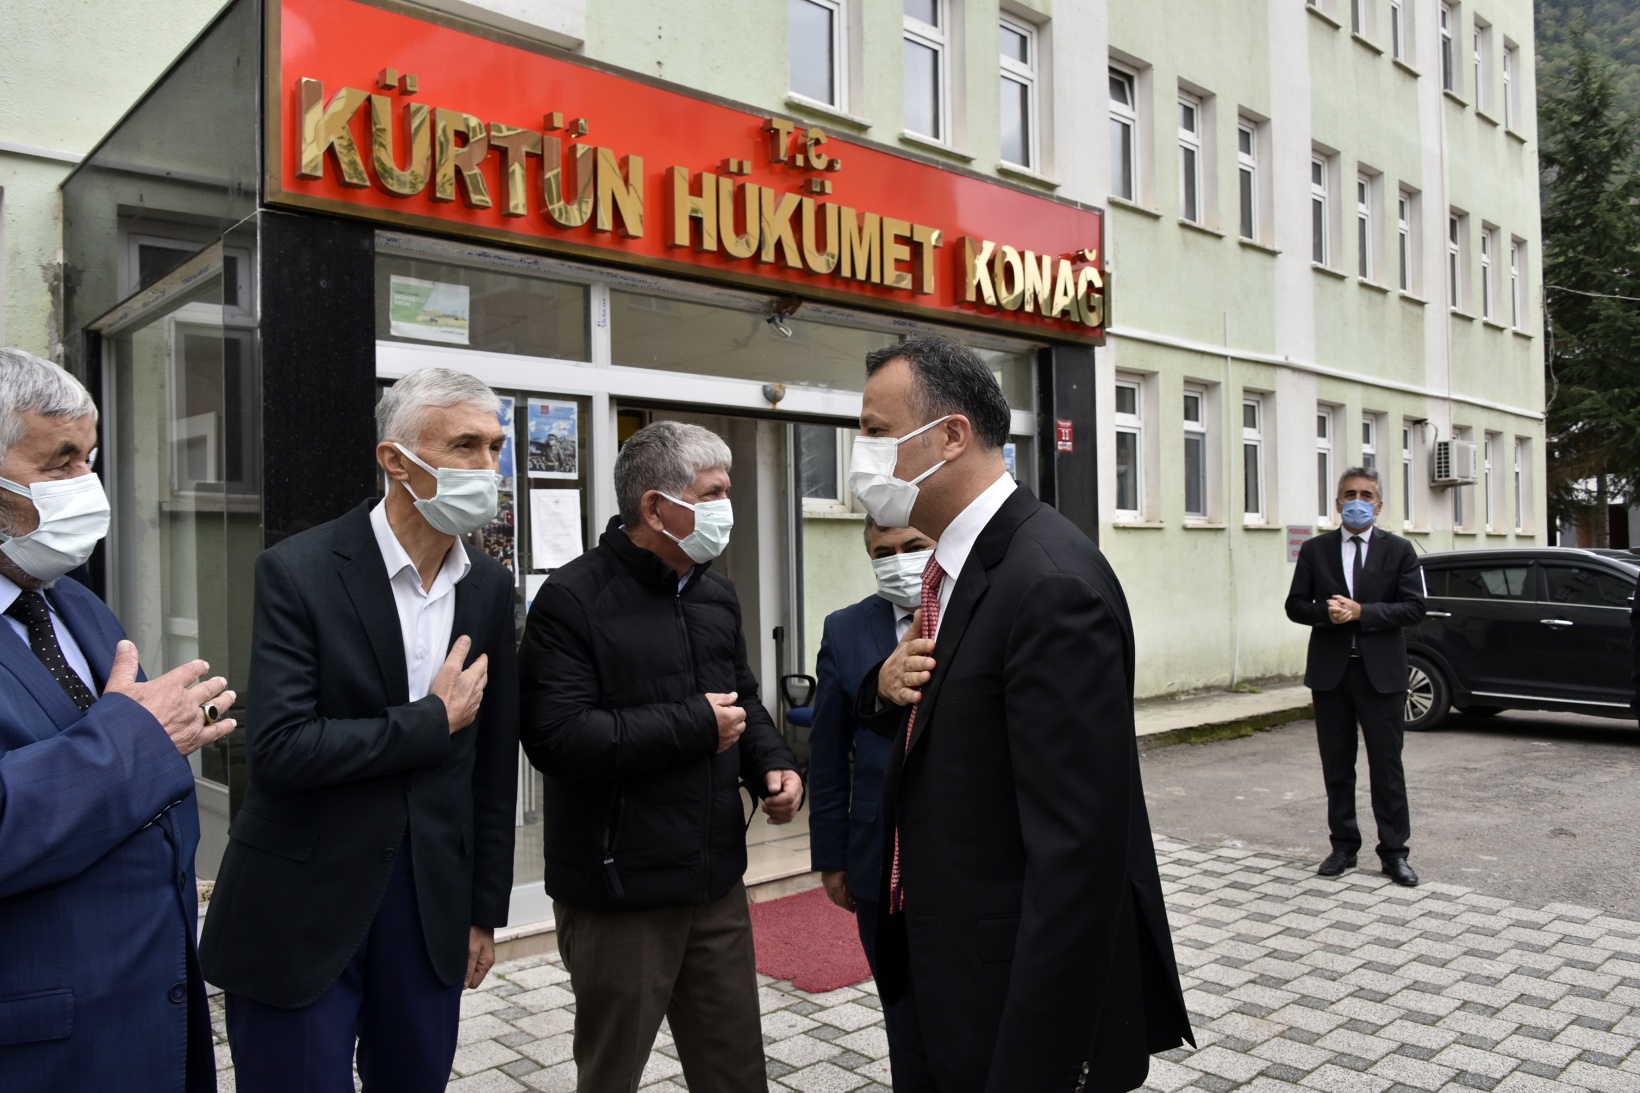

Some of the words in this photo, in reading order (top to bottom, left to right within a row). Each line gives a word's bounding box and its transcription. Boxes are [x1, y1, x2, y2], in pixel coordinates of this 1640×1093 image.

[295, 67, 643, 240] KÜRTÜN
[665, 157, 943, 296] HÜKÜMET
[764, 117, 841, 172] T.C.
